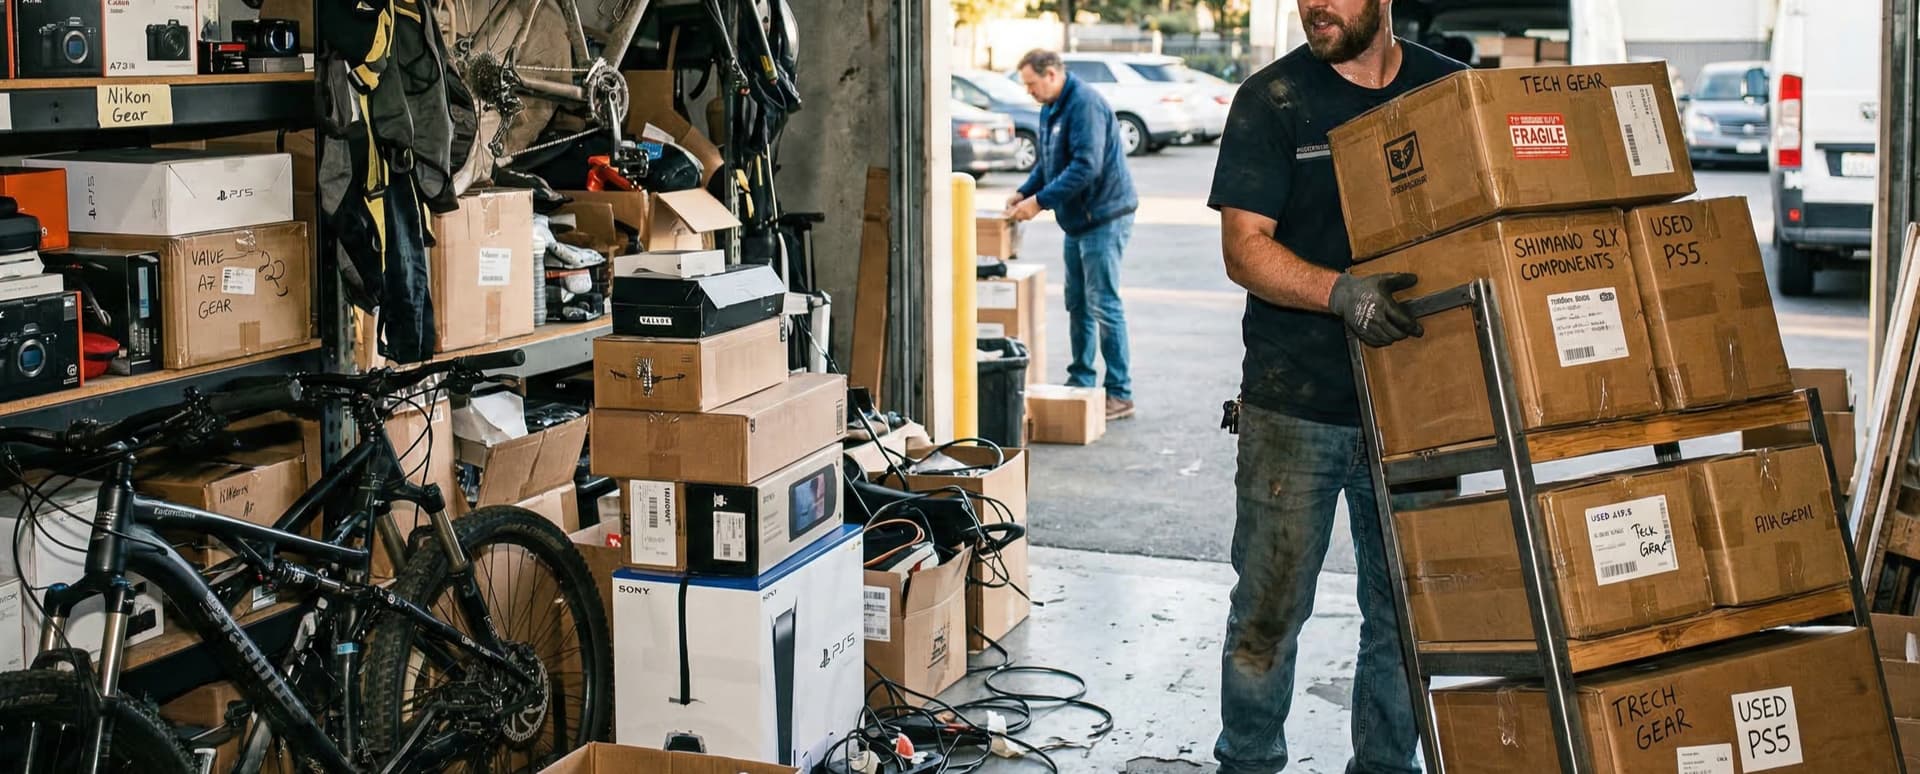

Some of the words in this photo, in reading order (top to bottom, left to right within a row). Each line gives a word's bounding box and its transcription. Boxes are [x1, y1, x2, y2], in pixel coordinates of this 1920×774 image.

[1519, 75, 1562, 95] TECH
[1566, 72, 1607, 92] GEAR
[107, 86, 151, 105] Nikon
[112, 107, 149, 123] Gear
[1511, 127, 1566, 145] FRAGILE
[229, 187, 254, 199] PS5
[1650, 215, 1693, 236] USED
[1514, 232, 1584, 258] SHIMANO
[1593, 228, 1620, 249] SLX
[1521, 252, 1615, 281] COMPONENTS
[198, 298, 233, 319] GEAR
[1591, 511, 1610, 522] USED
[618, 585, 651, 595] SONY
[832, 631, 856, 660] PS5
[1612, 684, 1677, 728] TRECH
[1738, 695, 1787, 722] USED
[1636, 707, 1693, 750] GEAR
[1748, 724, 1791, 760] PS5
